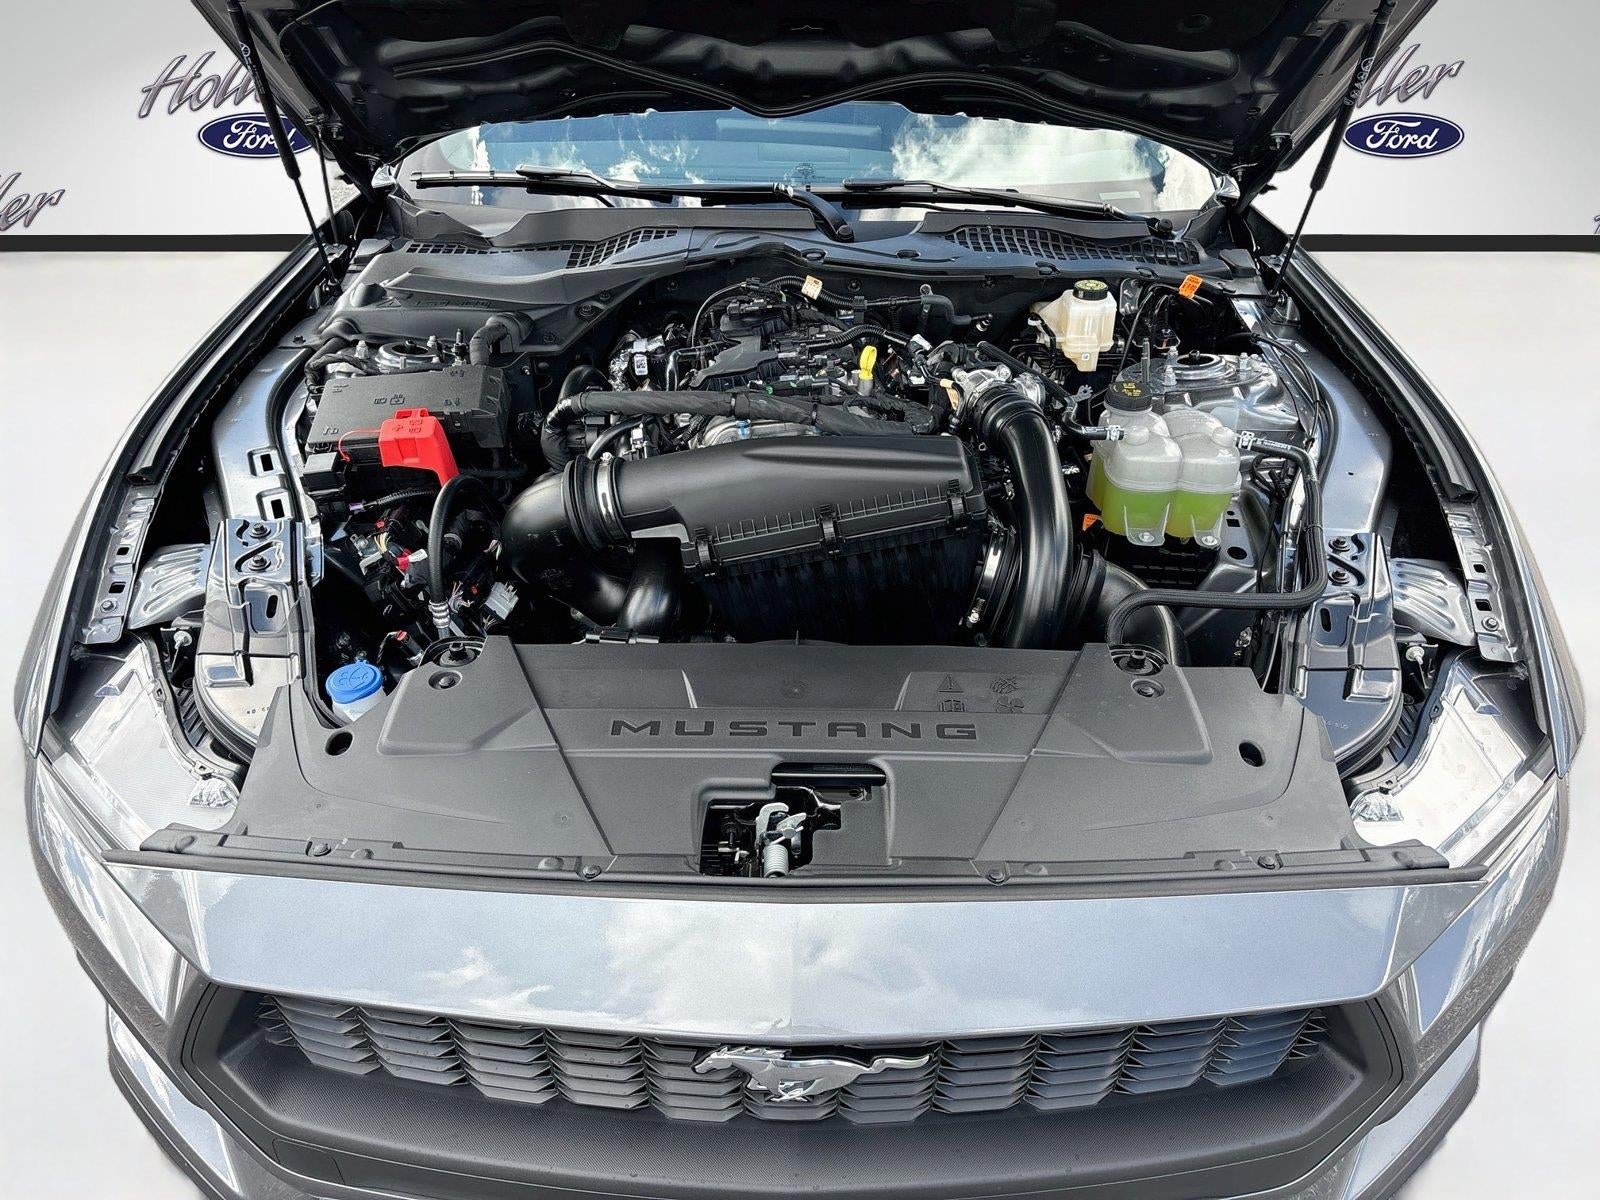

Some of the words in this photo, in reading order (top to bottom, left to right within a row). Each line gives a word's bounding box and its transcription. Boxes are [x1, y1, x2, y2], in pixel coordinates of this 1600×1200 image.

[138, 50, 261, 118] Holl
[1366, 119, 1440, 150] Ford
[610, 719, 978, 741] MUSTANG
